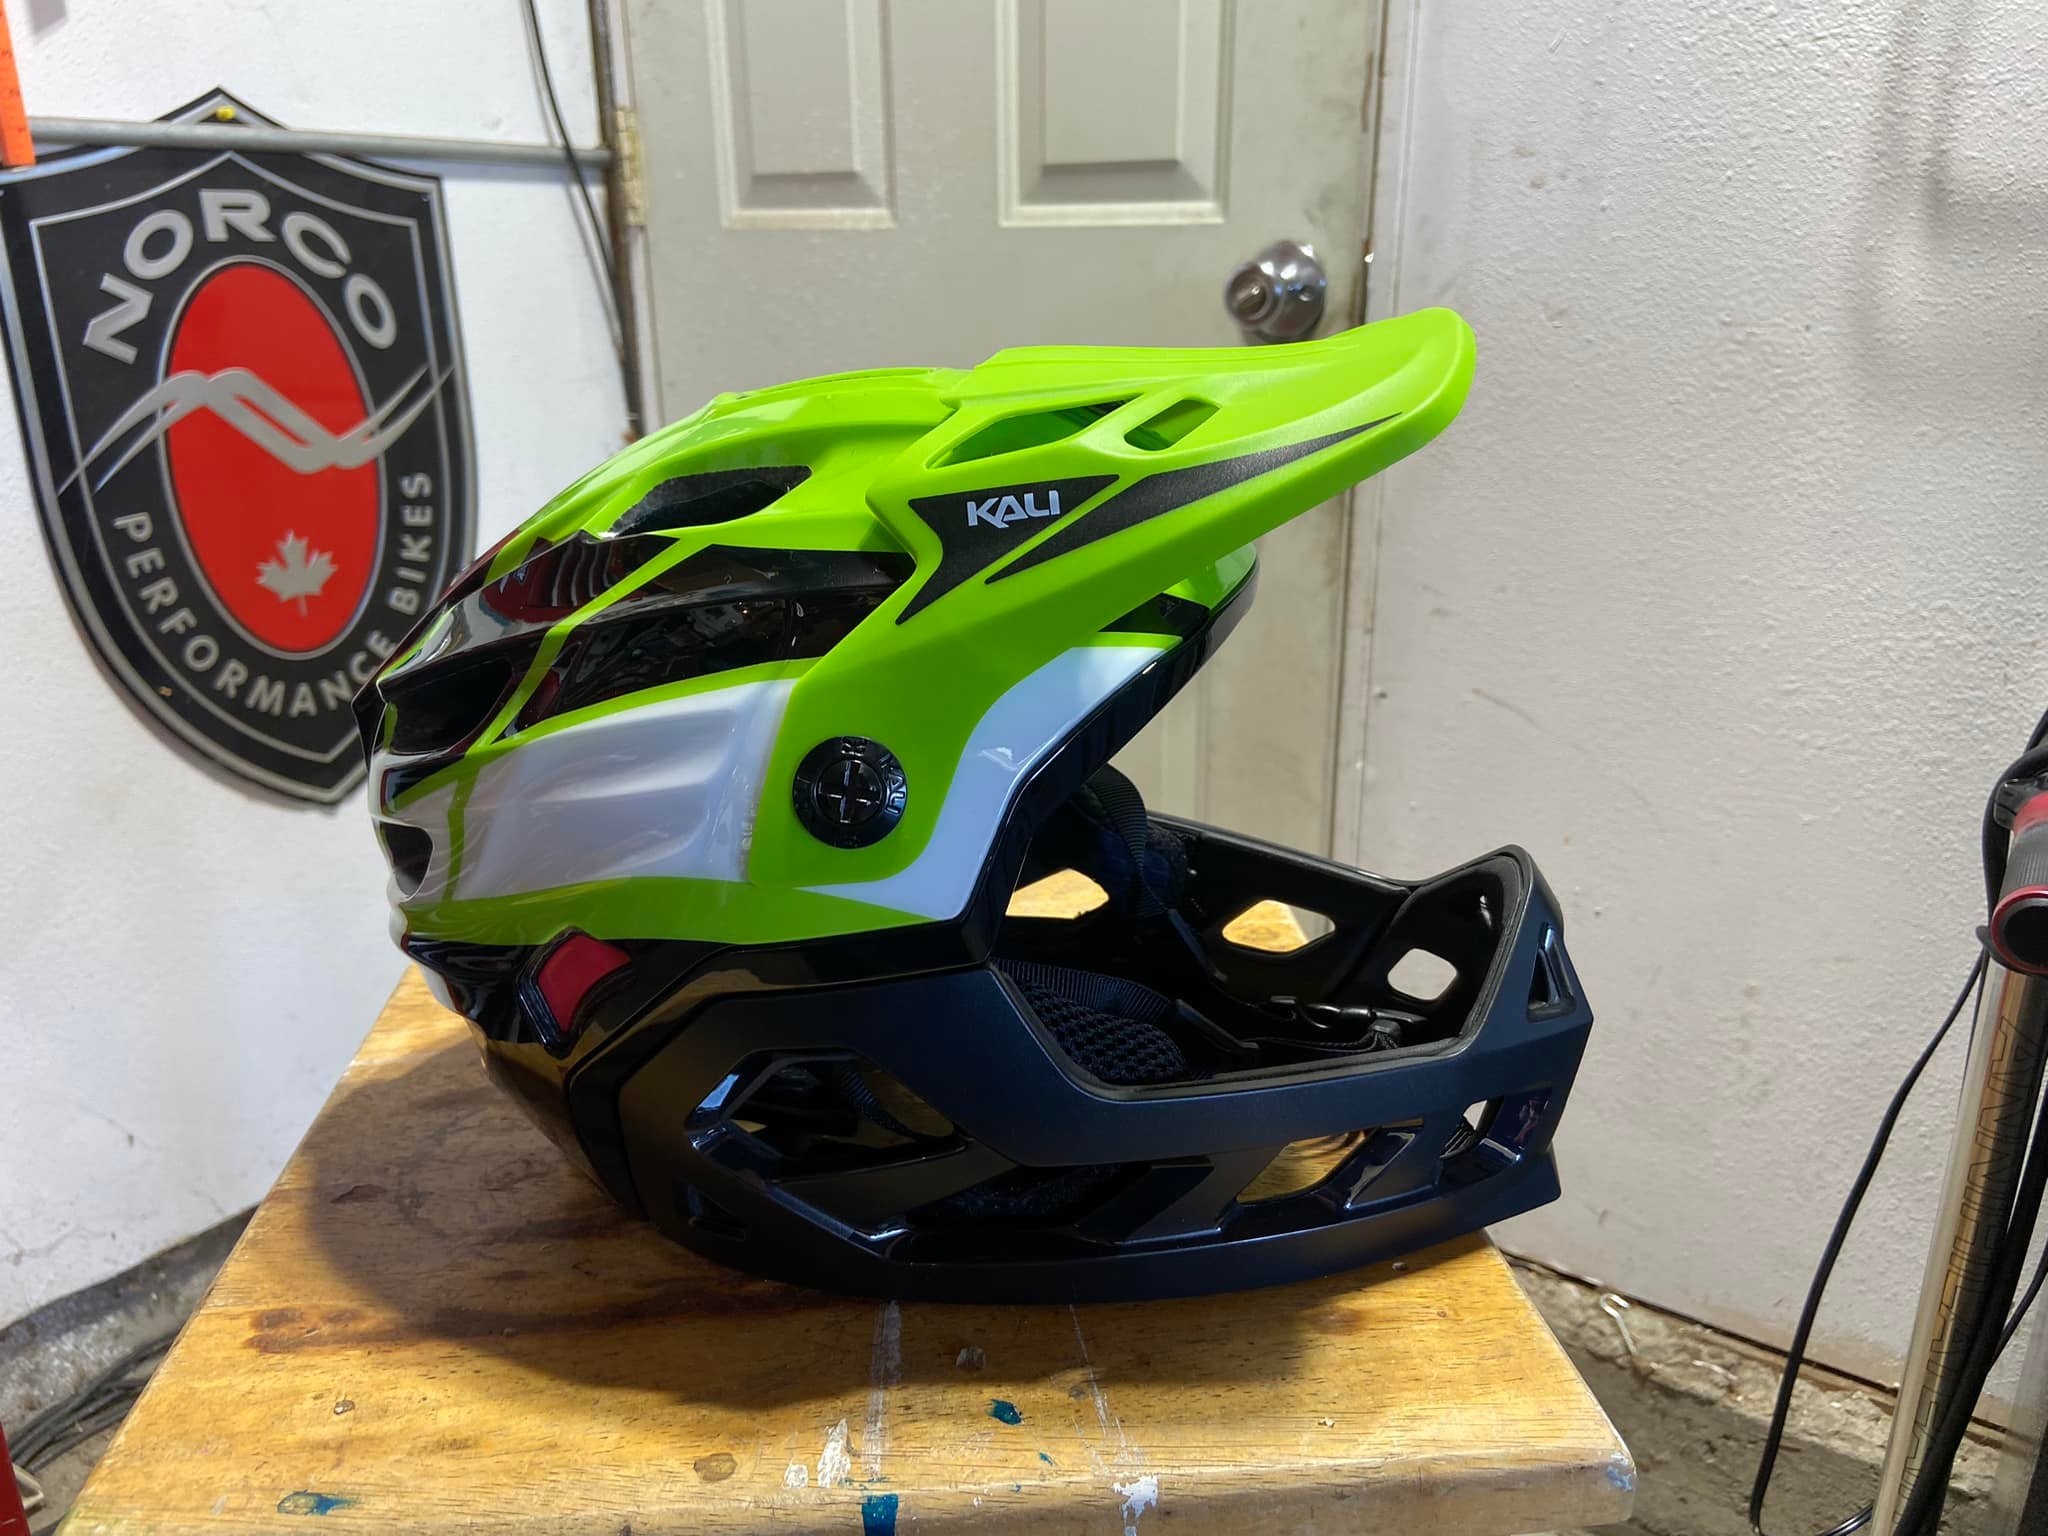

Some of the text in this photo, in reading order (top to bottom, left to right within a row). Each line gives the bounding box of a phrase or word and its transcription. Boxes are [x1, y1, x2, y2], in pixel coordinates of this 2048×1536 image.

[82, 188, 397, 364] NORCO
[113, 472, 433, 718] PERFORMANCE BIKES
[967, 489, 1061, 528] KALI
